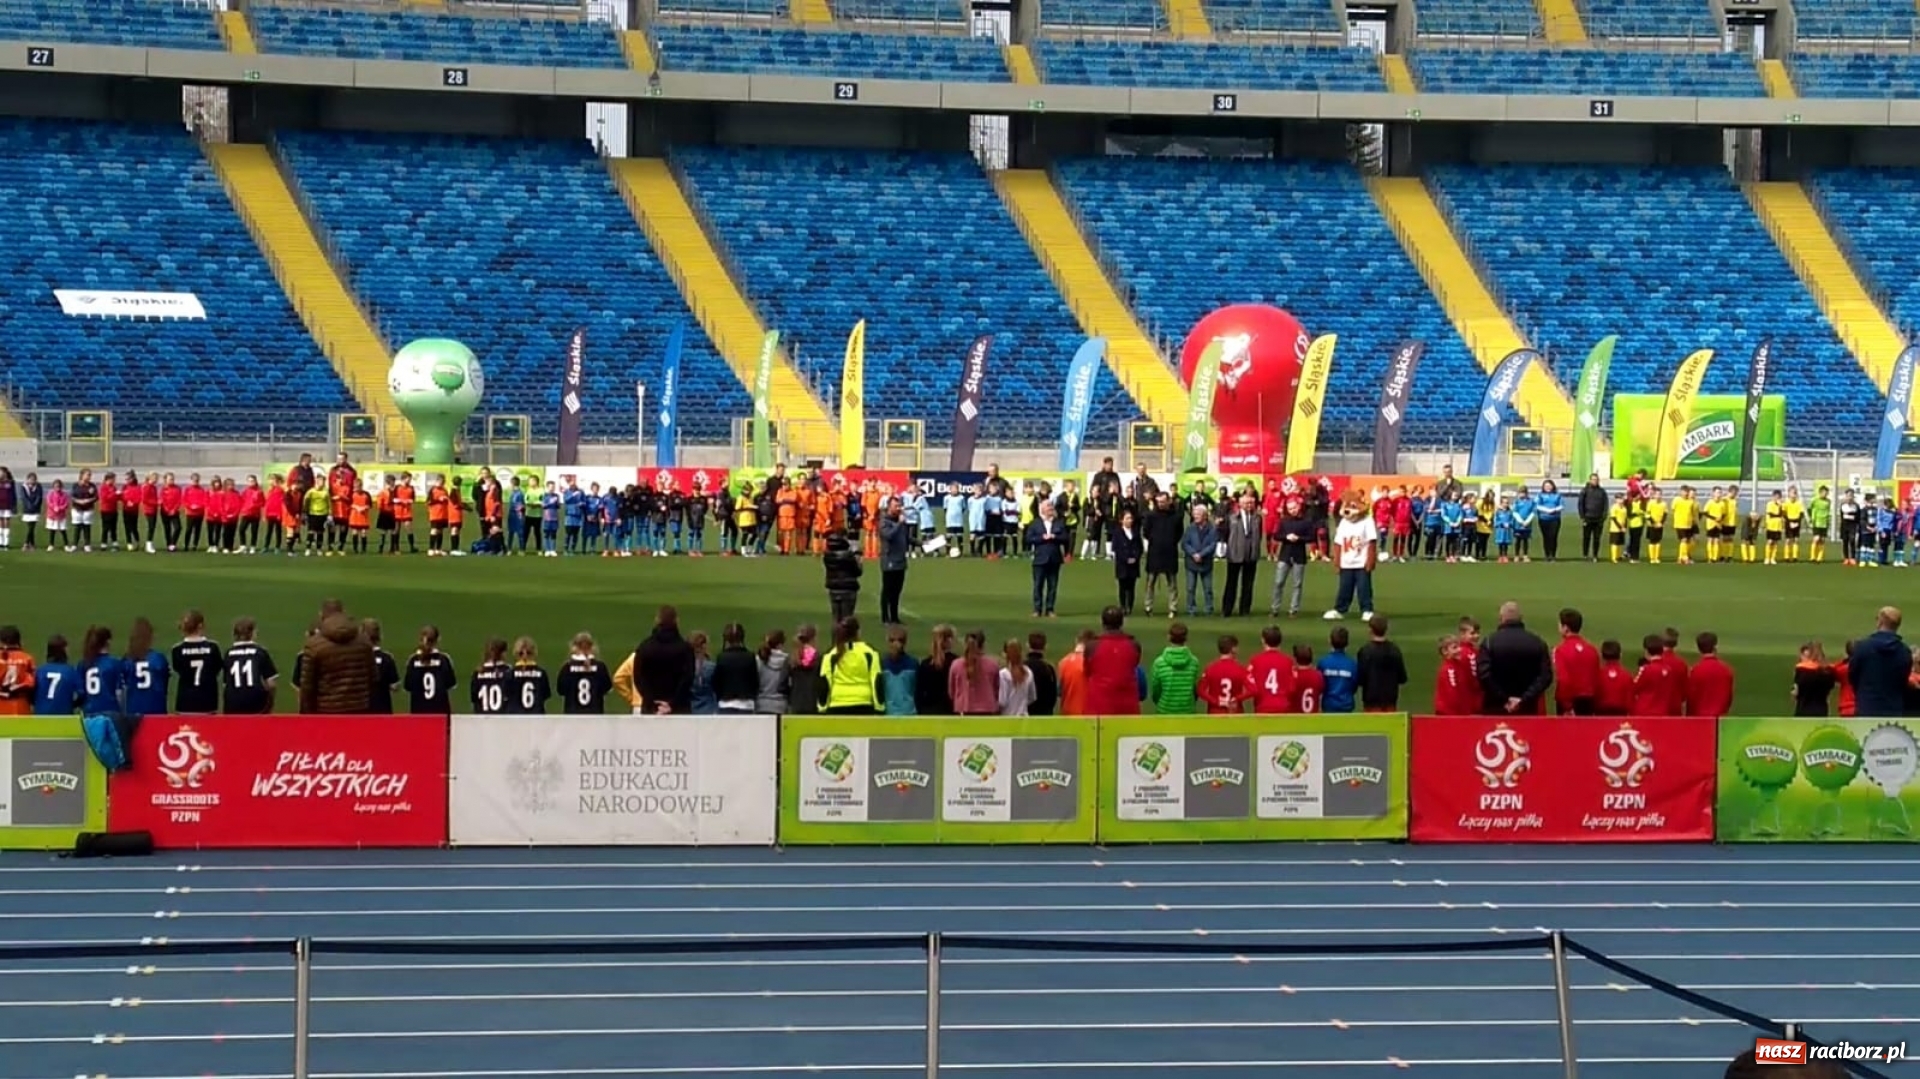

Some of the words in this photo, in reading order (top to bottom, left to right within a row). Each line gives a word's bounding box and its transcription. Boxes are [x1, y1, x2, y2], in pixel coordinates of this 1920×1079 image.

[32, 50, 49, 64] 27
[448, 70, 462, 84] 28
[838, 84, 854, 97] 29
[1218, 96, 1232, 108] 30
[1594, 102, 1608, 115] 31
[964, 340, 988, 394] Śląskie.
[1306, 339, 1328, 392] Śląskie.
[1386, 344, 1416, 398] Śląskie.
[1676, 354, 1704, 403] Śląskie.
[1892, 351, 1912, 403] Śląskie.
[1068, 362, 1092, 422] Śląskie.
[86, 668, 100, 695] 6
[136, 662, 151, 688] 5
[190, 660, 204, 686] 7
[230, 660, 253, 688] 11
[1264, 669, 1278, 694] 4
[46, 672, 62, 698] 7
[423, 672, 436, 700] 9
[522, 682, 534, 708] 6
[578, 678, 590, 705] 8
[1219, 678, 1232, 706] 3
[478, 684, 502, 711] 10
[1302, 688, 1314, 713] 6
[276, 751, 346, 772] PIŁKA
[346, 760, 373, 772] DLA
[579, 749, 688, 767] MINISTER
[1748, 747, 1790, 760] TYMBARK
[1806, 752, 1852, 764] TYMBARK
[20, 772, 75, 787] TYMBARK
[579, 772, 688, 792] EDUKACJI
[877, 770, 925, 784] TYMBARK
[1021, 770, 1067, 784] TYMBARK
[1194, 768, 1240, 782] TYMBARK
[1332, 767, 1378, 780] TYMBARK
[251, 772, 408, 798] WSZYSTKICH
[151, 794, 220, 804] GRASSROOTS
[578, 795, 724, 814] NARODOWEJ
[1480, 794, 1523, 810] PZPN
[1603, 794, 1646, 809] PZPN
[171, 811, 200, 822] PZPN
[1459, 814, 1491, 830] Łączy
[1492, 816, 1513, 827] nas
[1514, 814, 1543, 832] piłka
[1582, 814, 1614, 830] Łączy
[1616, 816, 1636, 827] nas
[1636, 813, 1665, 832] piłka
